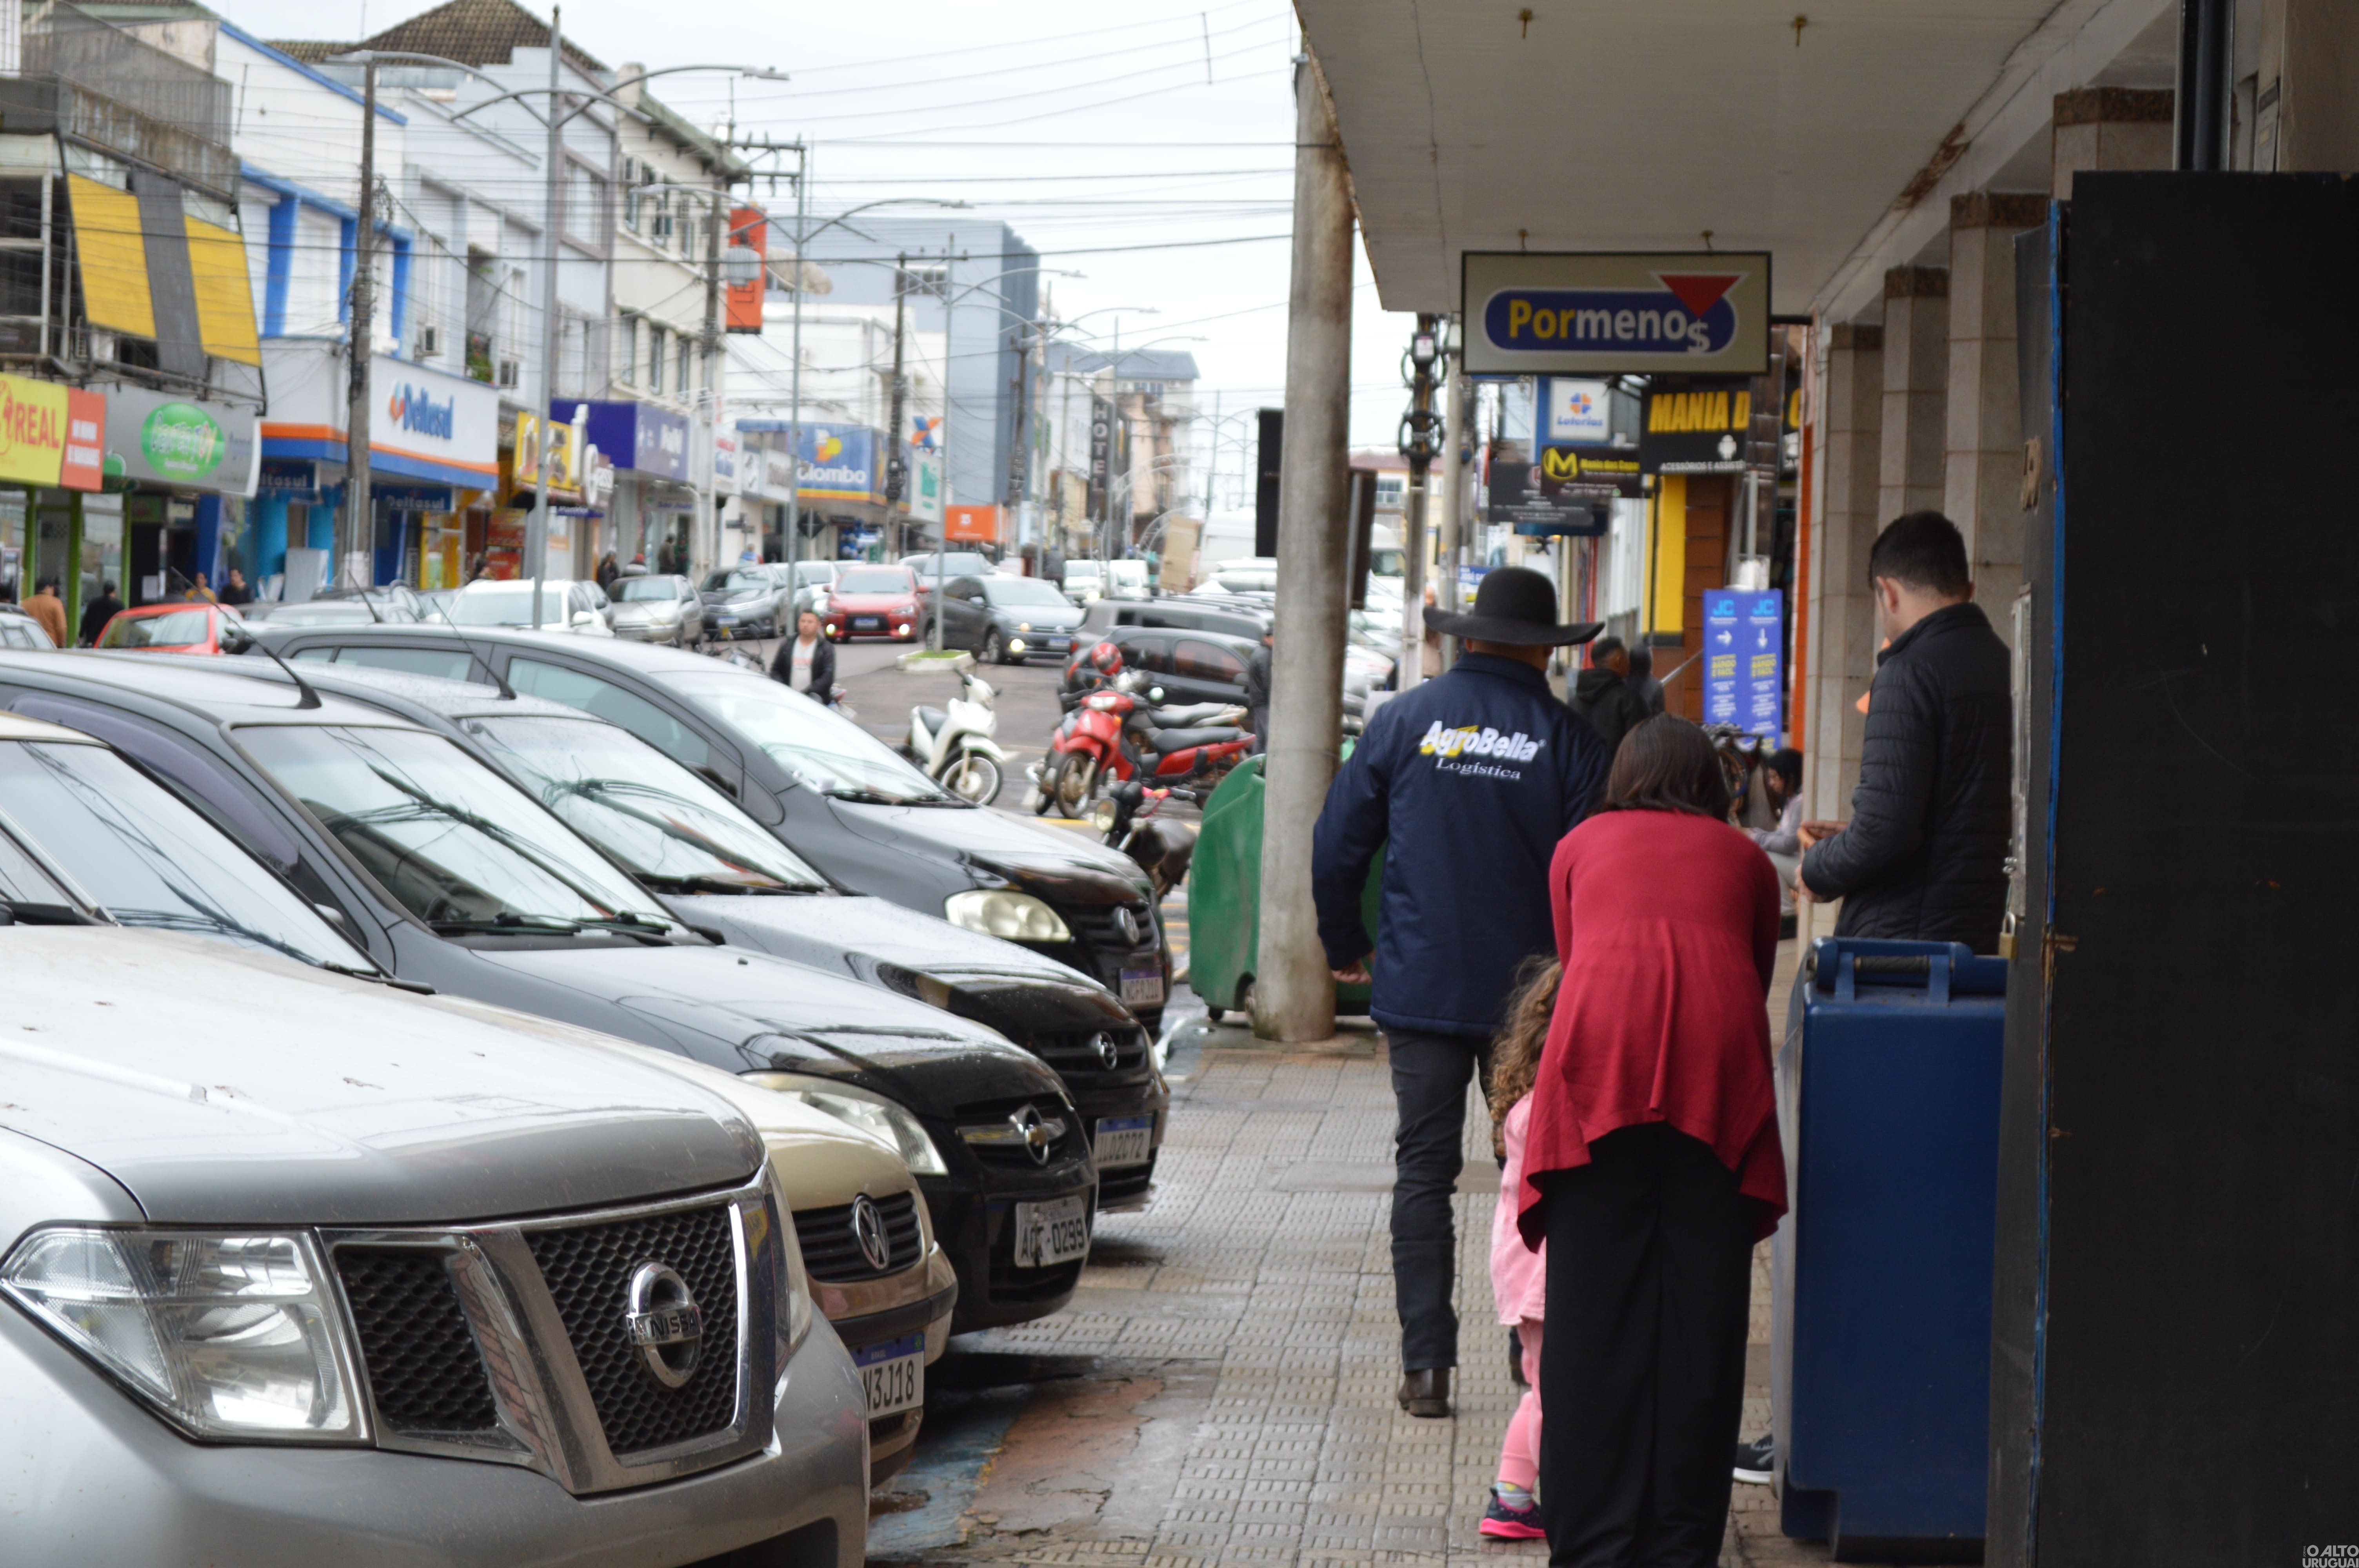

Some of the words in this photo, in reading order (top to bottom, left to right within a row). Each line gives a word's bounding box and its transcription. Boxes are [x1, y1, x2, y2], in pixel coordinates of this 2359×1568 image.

[1557, 415, 1603, 428] Loterias
[1649, 391, 1729, 432] MANIA
[15, 401, 60, 449] REAL
[1093, 404, 1107, 491] HOTEL
[796, 461, 867, 484] olombo
[1713, 599, 1735, 615] JC
[1753, 599, 1775, 615] JC
[1435, 757, 1521, 780] Logística
[649, 1312, 698, 1337] NISSA
